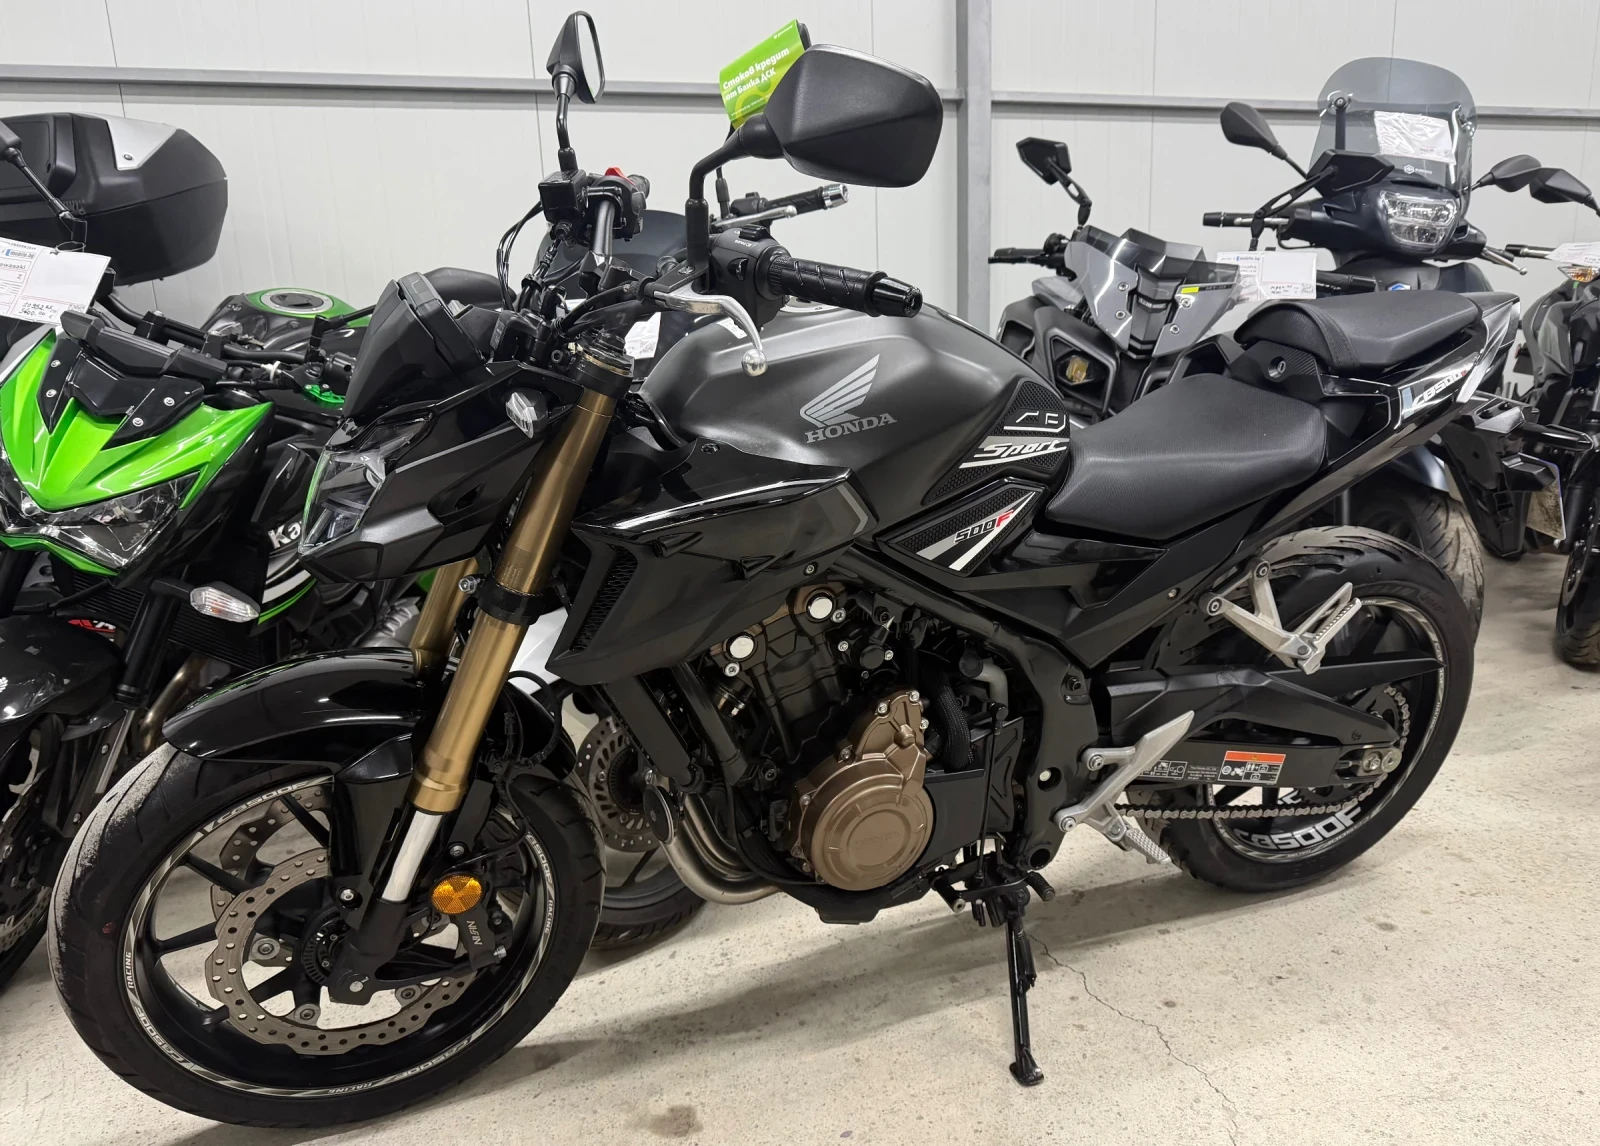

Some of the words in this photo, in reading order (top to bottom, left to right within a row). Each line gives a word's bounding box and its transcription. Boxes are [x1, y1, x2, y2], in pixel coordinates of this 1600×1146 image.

[723, 66, 754, 90] Стоков
[755, 48, 790, 70] кредит
[725, 92, 737, 100] от
[737, 78, 760, 94] Банка
[761, 68, 777, 84] ДСК
[804, 412, 898, 444] HONDA
[974, 439, 1066, 458] Sport
[268, 520, 302, 549] Ka
[954, 509, 1014, 544] 500F
[1234, 807, 1362, 850] CB500F
[545, 900, 554, 934] RACING
[125, 951, 135, 989] RACING
